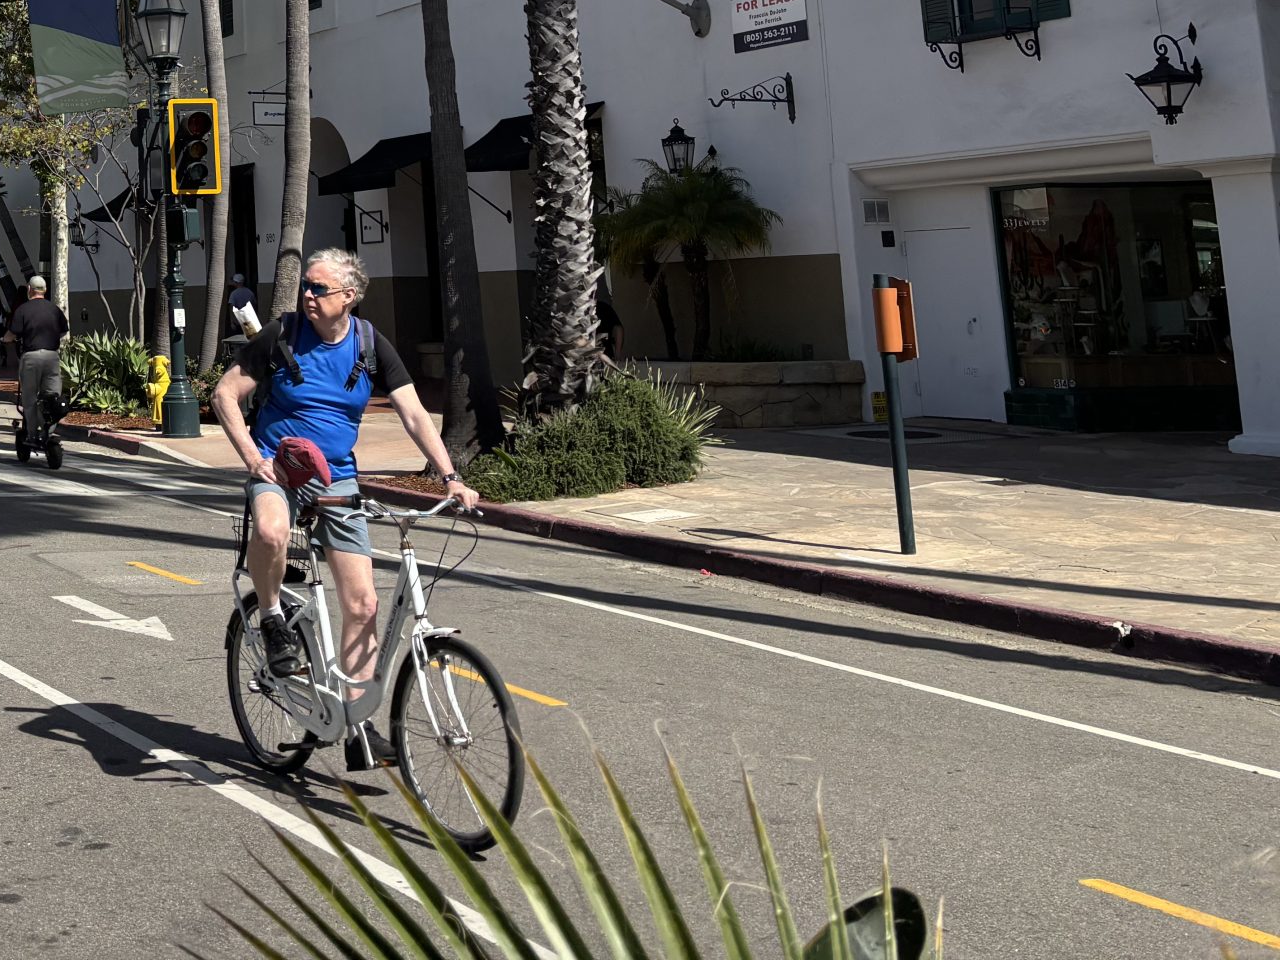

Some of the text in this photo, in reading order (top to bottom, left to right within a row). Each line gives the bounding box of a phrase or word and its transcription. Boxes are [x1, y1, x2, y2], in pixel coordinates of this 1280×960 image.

[736, 0, 758, 13] FOR
[743, 25, 797, 44] (805) 563-2111
